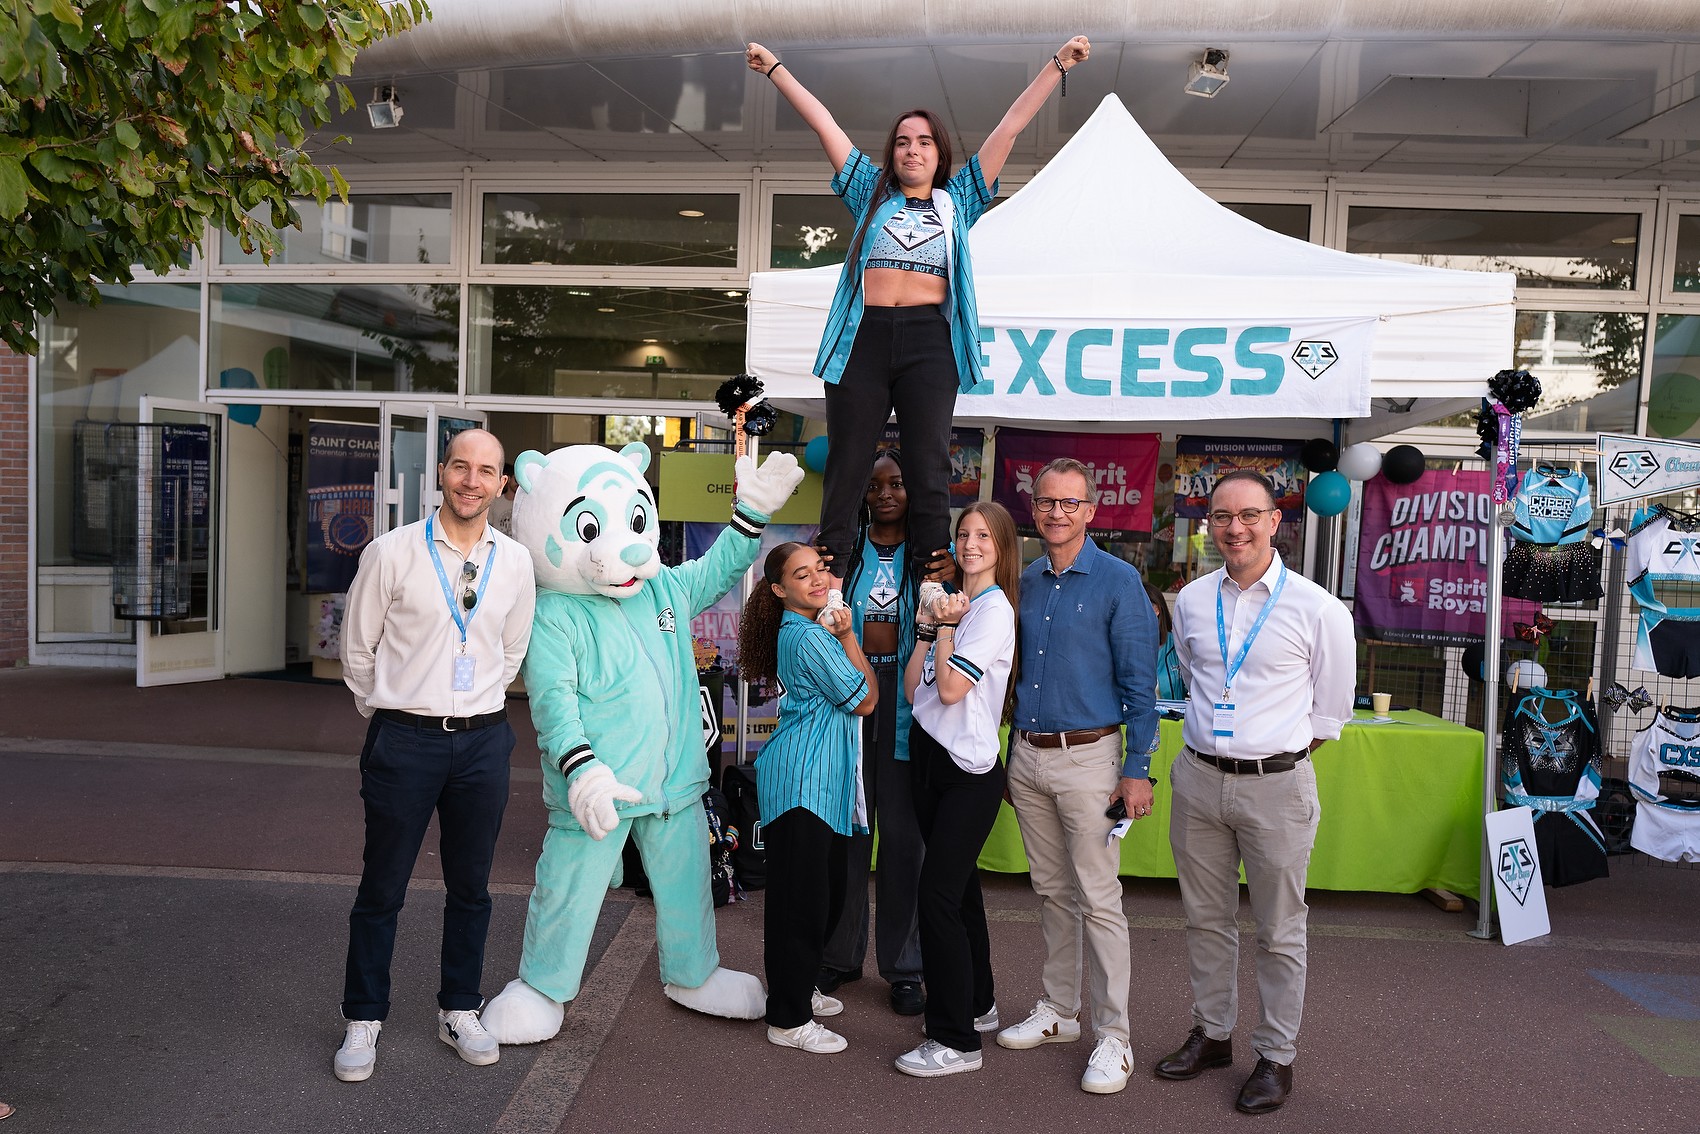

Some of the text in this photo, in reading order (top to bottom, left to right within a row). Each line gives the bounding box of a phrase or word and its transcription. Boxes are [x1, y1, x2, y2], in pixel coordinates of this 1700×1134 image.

[867, 260, 900, 269] OSSIBLE
[901, 262, 911, 270] IS
[913, 264, 932, 274] NOT
[962, 326, 1291, 398] EXCESS
[310, 436, 380, 450] SAINT CHAR
[1205, 444, 1283, 452] DIVISION WINNER
[309, 448, 347, 457] Charenton
[353, 450, 371, 458] Saint
[1087, 462, 1127, 485] irit
[1094, 486, 1142, 506] yale
[1531, 496, 1572, 509] CHEER
[1391, 491, 1490, 526] DIVISIO
[1529, 505, 1573, 518] EXCESS
[1429, 577, 1488, 597] Spirit
[1428, 595, 1487, 615] Royal
[877, 614, 885, 622] IS
[870, 655, 897, 663] IS NOT
[1358, 697, 1370, 705] JBL
